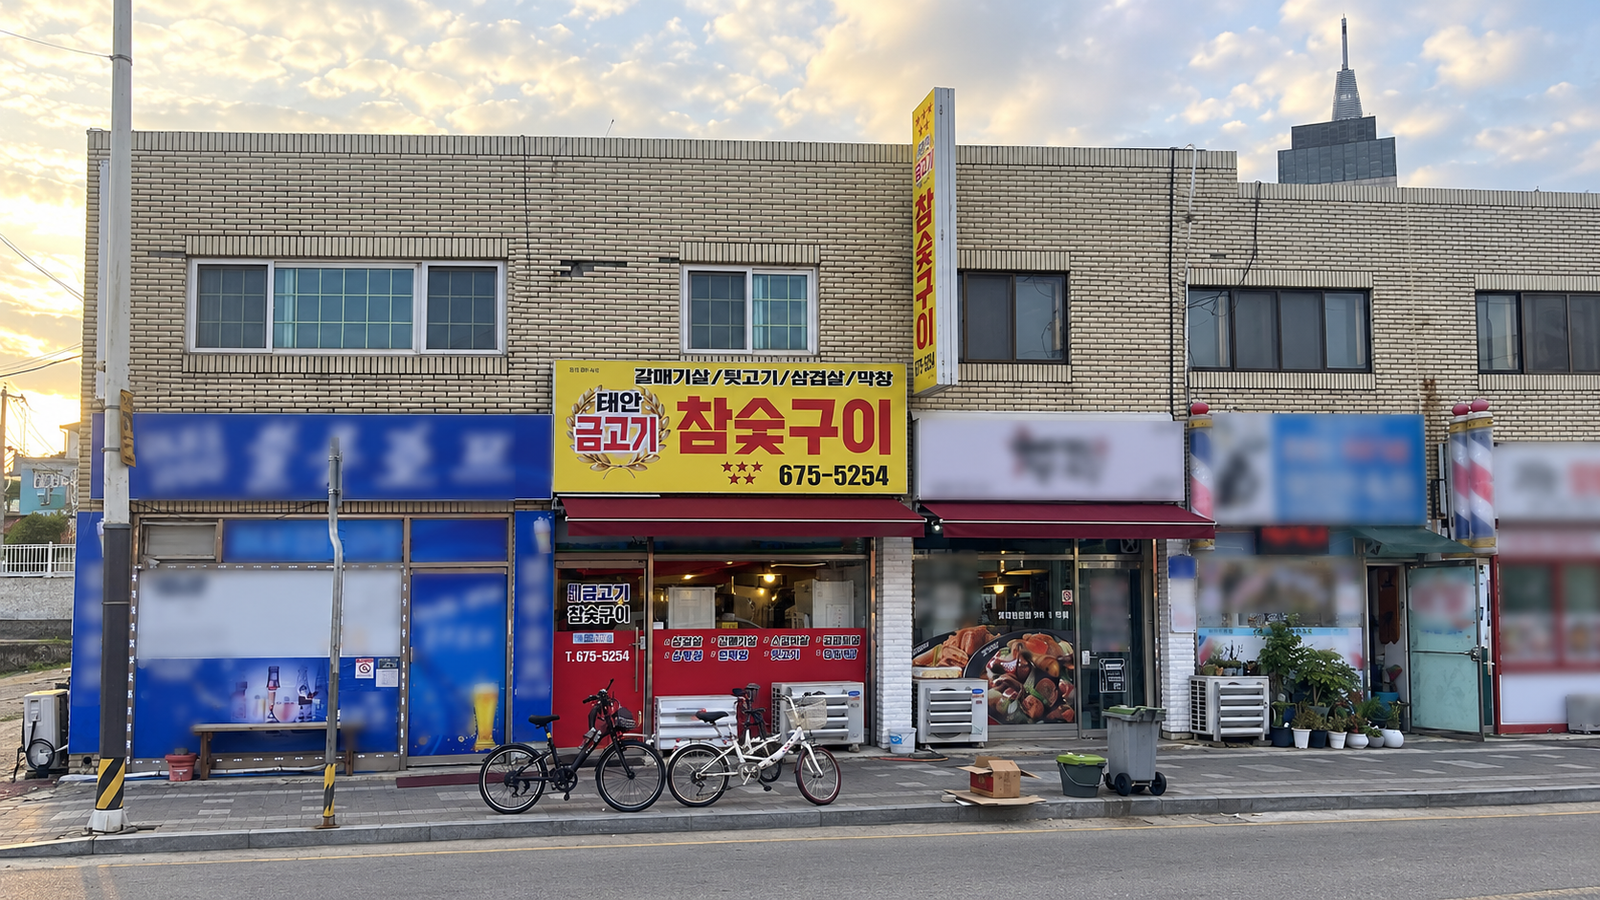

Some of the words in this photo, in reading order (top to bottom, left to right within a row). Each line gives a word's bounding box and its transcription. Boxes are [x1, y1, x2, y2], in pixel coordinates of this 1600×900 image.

[915, 187, 934, 350] 참숯구이
[596, 391, 643, 413] 태안
[575, 415, 659, 453] 금고기
[677, 396, 891, 456] 참숯구이
[779, 464, 889, 487] 675-5254
